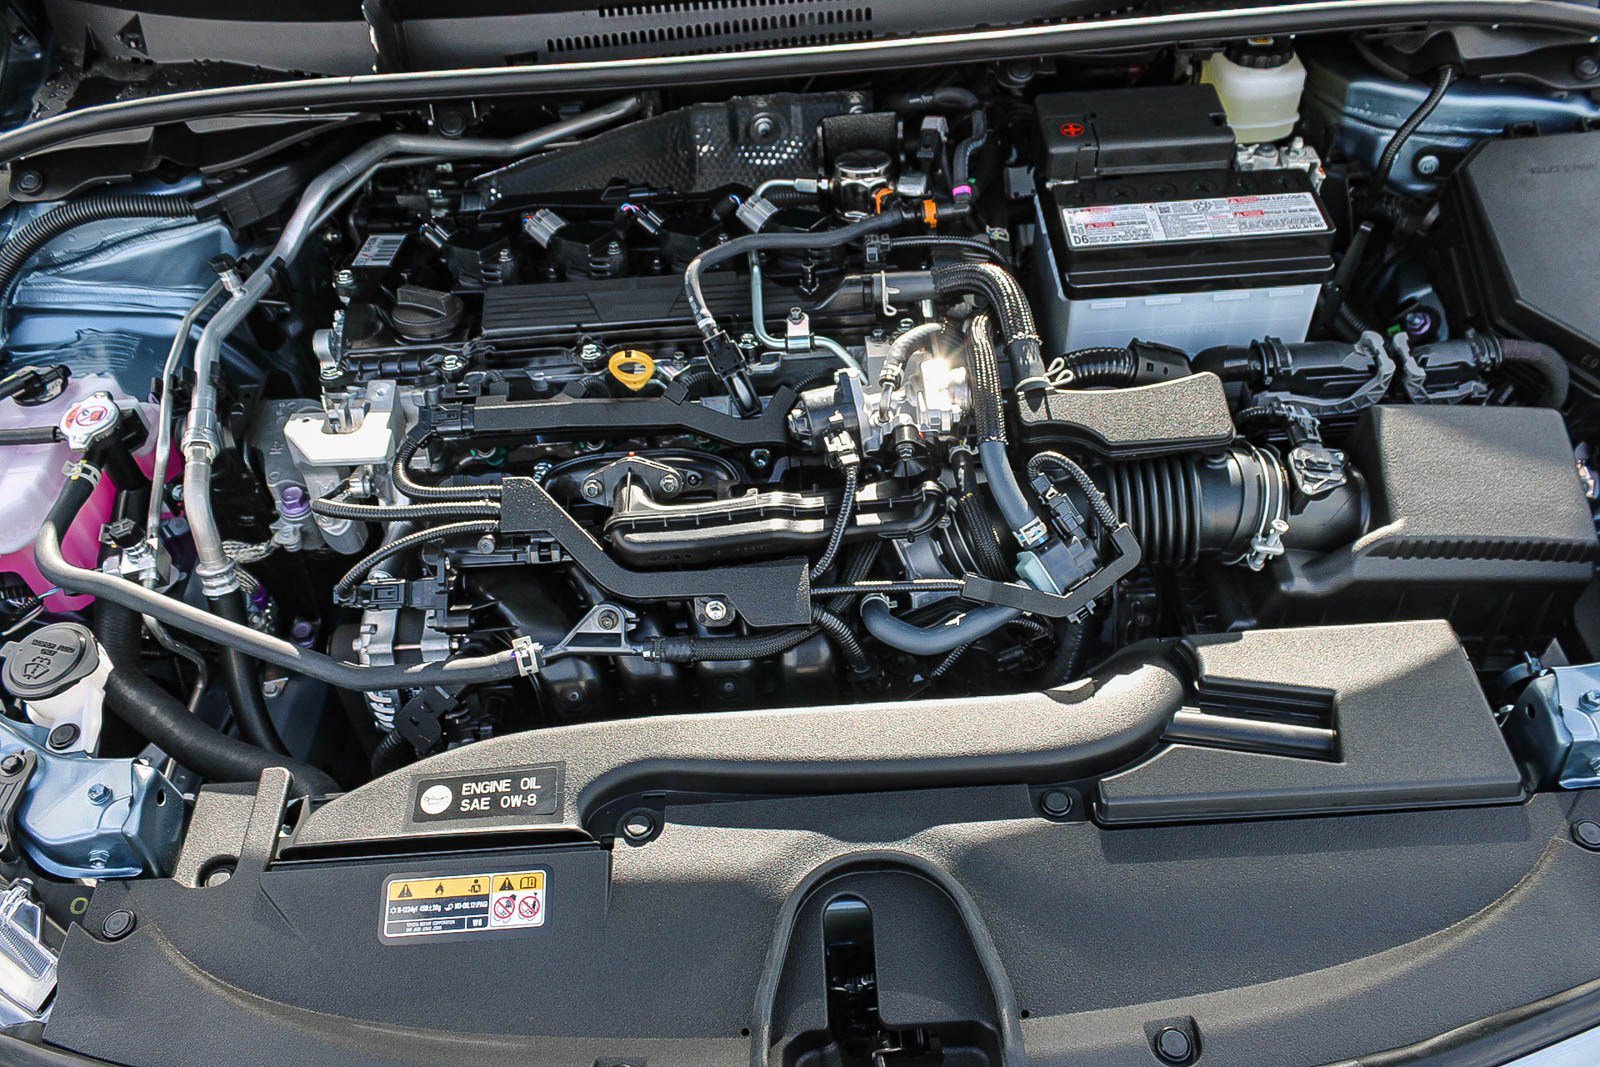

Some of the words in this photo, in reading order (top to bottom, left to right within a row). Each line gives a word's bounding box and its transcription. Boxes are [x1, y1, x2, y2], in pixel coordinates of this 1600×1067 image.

[1073, 235, 1089, 244] D6
[461, 779, 512, 795] ENGINE
[520, 777, 541, 790] OIL
[460, 797, 491, 811] SAE
